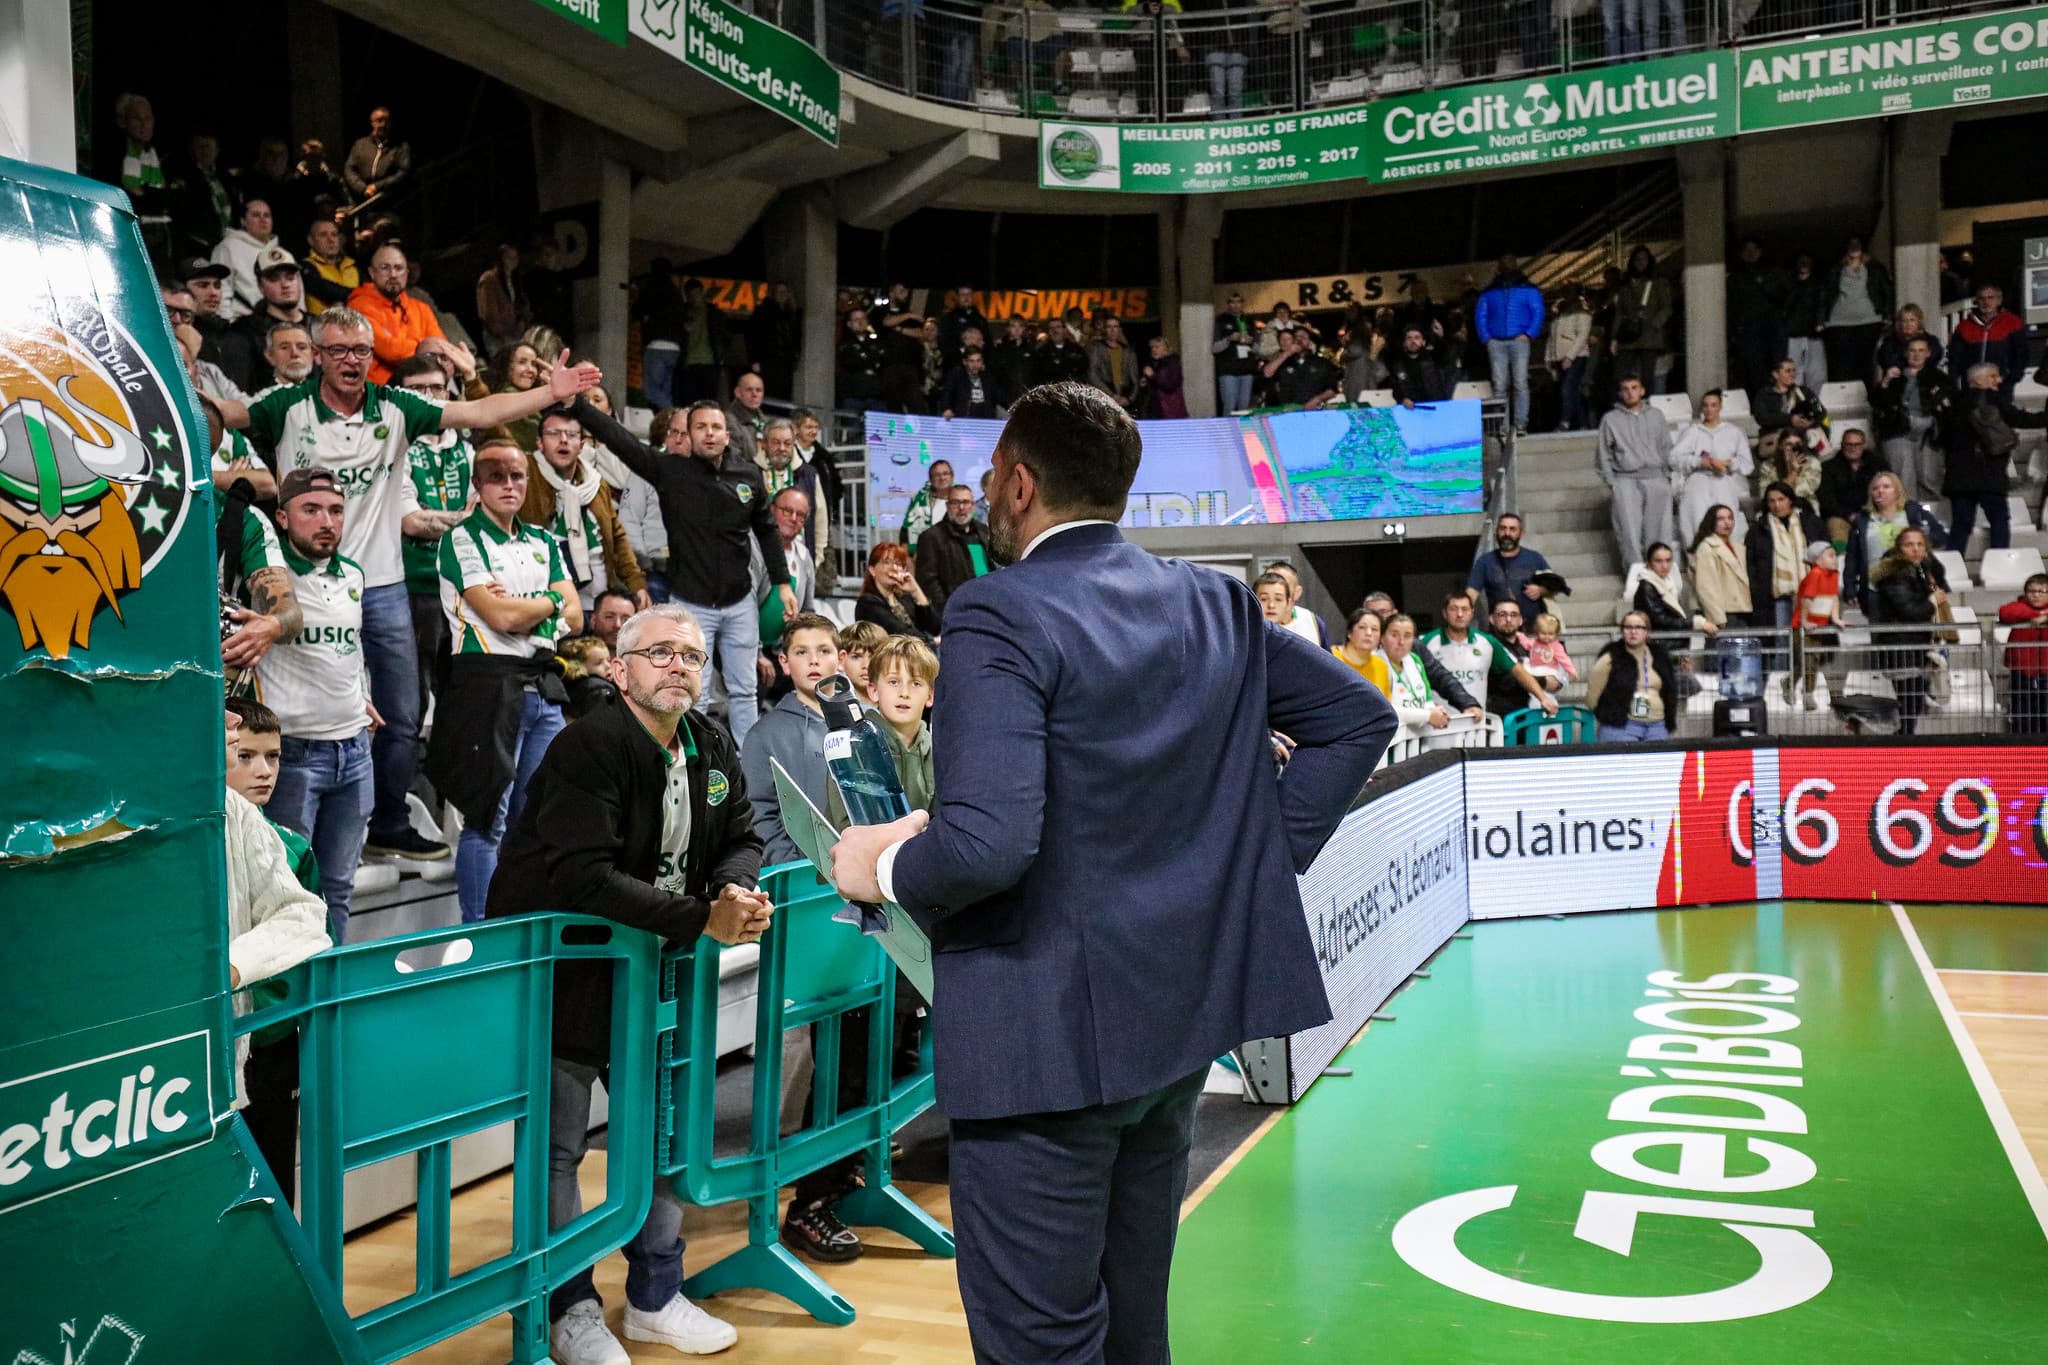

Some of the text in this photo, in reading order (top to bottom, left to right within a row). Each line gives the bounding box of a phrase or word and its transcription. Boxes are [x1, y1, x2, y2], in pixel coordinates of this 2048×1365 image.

[689, 0, 744, 44] Région
[1743, 32, 1961, 87] ANTENNES
[1911, 63, 1994, 85] surveillance
[689, 25, 838, 135] Hauts-de-France
[1956, 88, 1988, 100] Yokis
[1384, 63, 1718, 145] Crédit Mutuel
[1122, 110, 1368, 141] MEILLEUR PUBLIC DE FRANCE
[1489, 126, 1588, 149] Nord Europe
[1132, 162, 1172, 176] 2005
[1194, 160, 1233, 175] 2011
[1256, 154, 1297, 171] 2015
[1320, 146, 1360, 164] 2017
[1208, 139, 1281, 157] SAISONS
[1382, 161, 1441, 179] AGENCES
[1444, 159, 1462, 171] DE
[1466, 150, 1539, 169] BOULOGNE
[1552, 144, 1569, 158] LE
[1573, 138, 1626, 155] PORTEL
[1639, 124, 1716, 145] WIMEREUX
[1298, 276, 1383, 306] R & S
[77, 314, 150, 393] d'Opale
[1868, 777, 1999, 868] 69
[59, 1318, 78, 1344] N
